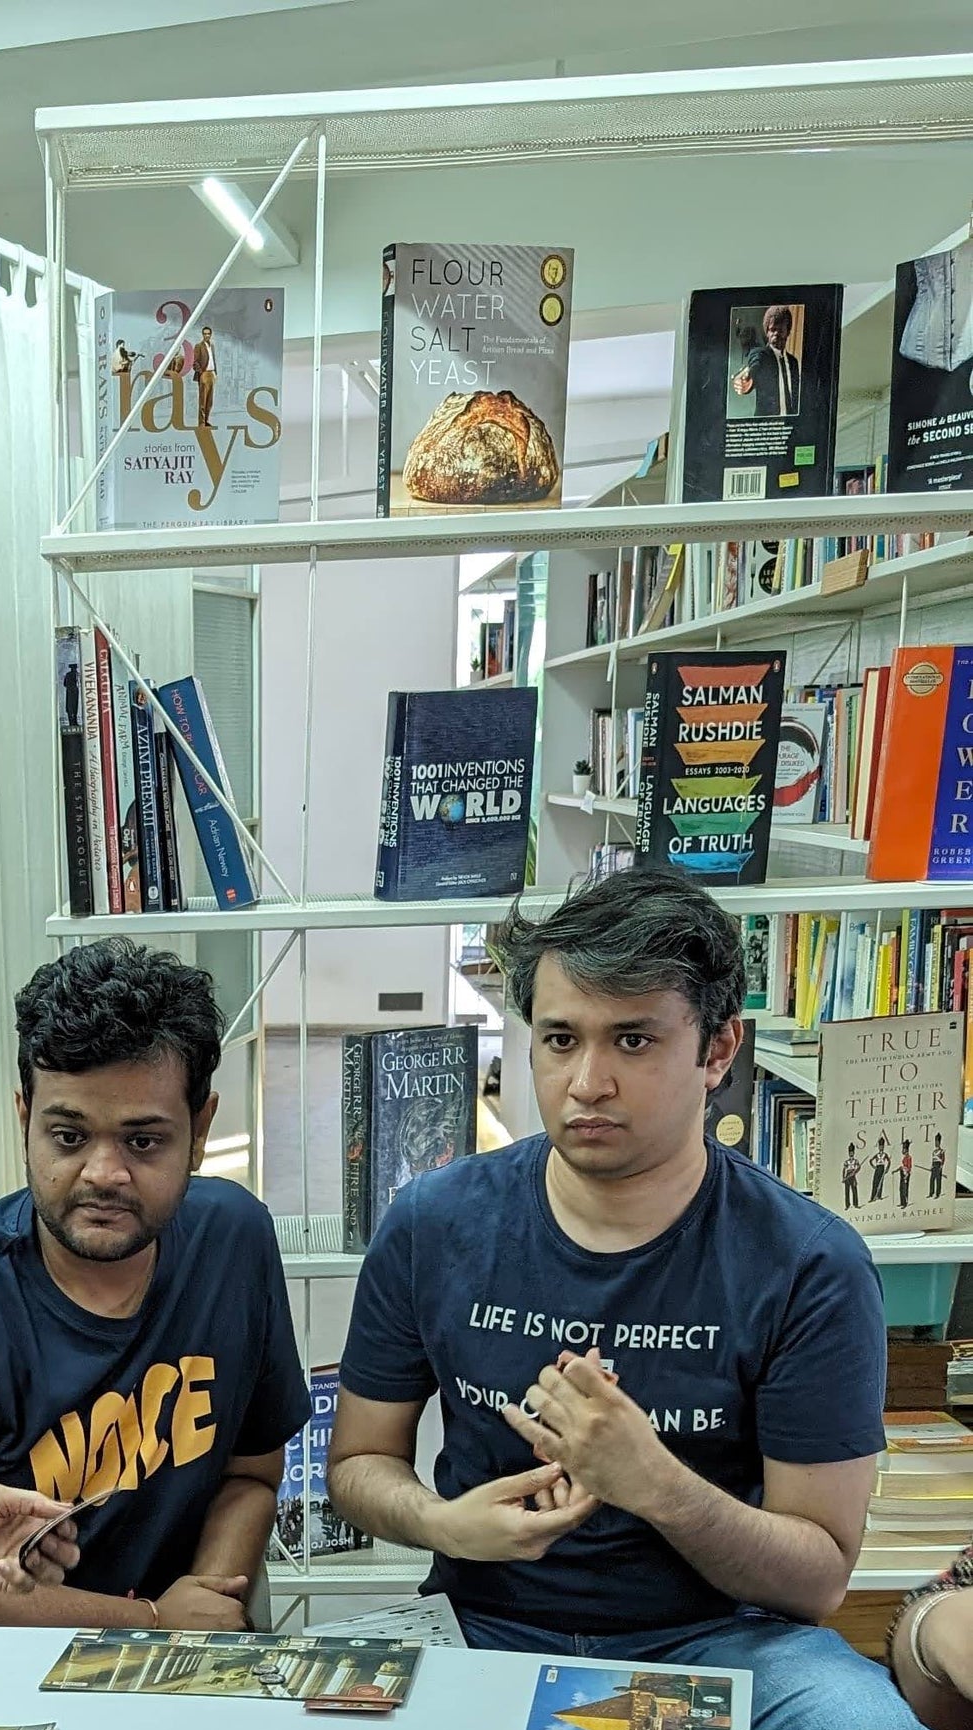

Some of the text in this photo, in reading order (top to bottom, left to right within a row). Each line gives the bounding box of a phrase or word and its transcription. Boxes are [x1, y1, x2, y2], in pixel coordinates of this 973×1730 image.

[411, 258, 504, 286] FLOUR
[410, 293, 505, 320] WATER
[152, 300, 195, 378] 3
[410, 326, 476, 352] SALT
[98, 354, 108, 420] RAYS
[379, 361, 388, 408] WATER
[410, 360, 497, 386] YEAST
[378, 412, 386, 443] SALT
[907, 417, 937, 431] SIMONE
[907, 434, 921, 446] the
[923, 425, 962, 443] SECOND
[144, 443, 196, 454] stories from
[124, 455, 196, 471] SATYAJIT
[377, 449, 386, 491] YEAST
[163, 471, 195, 485] RAY
[84, 661, 98, 741] VIVEKANANDA
[115, 684, 128, 722] ANIMAL
[681, 684, 764, 706] SALMAN
[171, 688, 185, 715] HOW
[179, 715, 190, 731] TO
[642, 692, 652, 748] RUSHDIE
[648, 692, 661, 747] SALMAN
[118, 723, 130, 751] FARM
[137, 723, 151, 764] AZIM
[678, 720, 763, 742] RUSHDIE
[411, 758, 525, 780] 1001 INVENTIONS
[685, 765, 750, 776] ESSAYS 2003-2020
[140, 764, 155, 827] PREMJI
[410, 775, 524, 794] THAT CHANGED THE
[389, 756, 402, 848] 1001 INVENTIONS
[635, 782, 645, 846] OF TRUTH
[641, 775, 655, 853] LANGUAGES
[663, 794, 766, 815] LANGUAGES
[73, 761, 88, 887] THE SYNAGOGUE
[208, 819, 222, 848] Adrian
[668, 833, 754, 854] OF TRUTH
[217, 846, 229, 878] Newey
[909, 917, 918, 961] FAMILY
[857, 1027, 942, 1054] TRUE
[353, 1043, 363, 1093] GEORGE
[382, 1051, 440, 1072] GEORGE
[860, 1055, 888, 1063] BRITISH
[889, 1053, 915, 1061] INDIAN
[917, 1051, 936, 1059] ARMY
[343, 1046, 355, 1115] MARTIN
[385, 1071, 465, 1101] MARTIN
[877, 1062, 918, 1084] TO
[863, 1085, 910, 1095] ALTERNATIVE
[912, 1082, 943, 1091] HISTORY
[845, 1091, 947, 1119] THEIR
[869, 1114, 934, 1126] DECOLONIZATION
[856, 1123, 936, 1150] SALT
[348, 1162, 360, 1226] FIRE AND
[848, 1207, 945, 1223] AVINDRA RATHEE
[468, 1302, 721, 1350] LIFE IS NOT PERFECT
[455, 1376, 509, 1414] YOUR
[648, 1407, 727, 1433] AN BE.
[288, 1535, 354, 1551] MAOJ JOSHI
